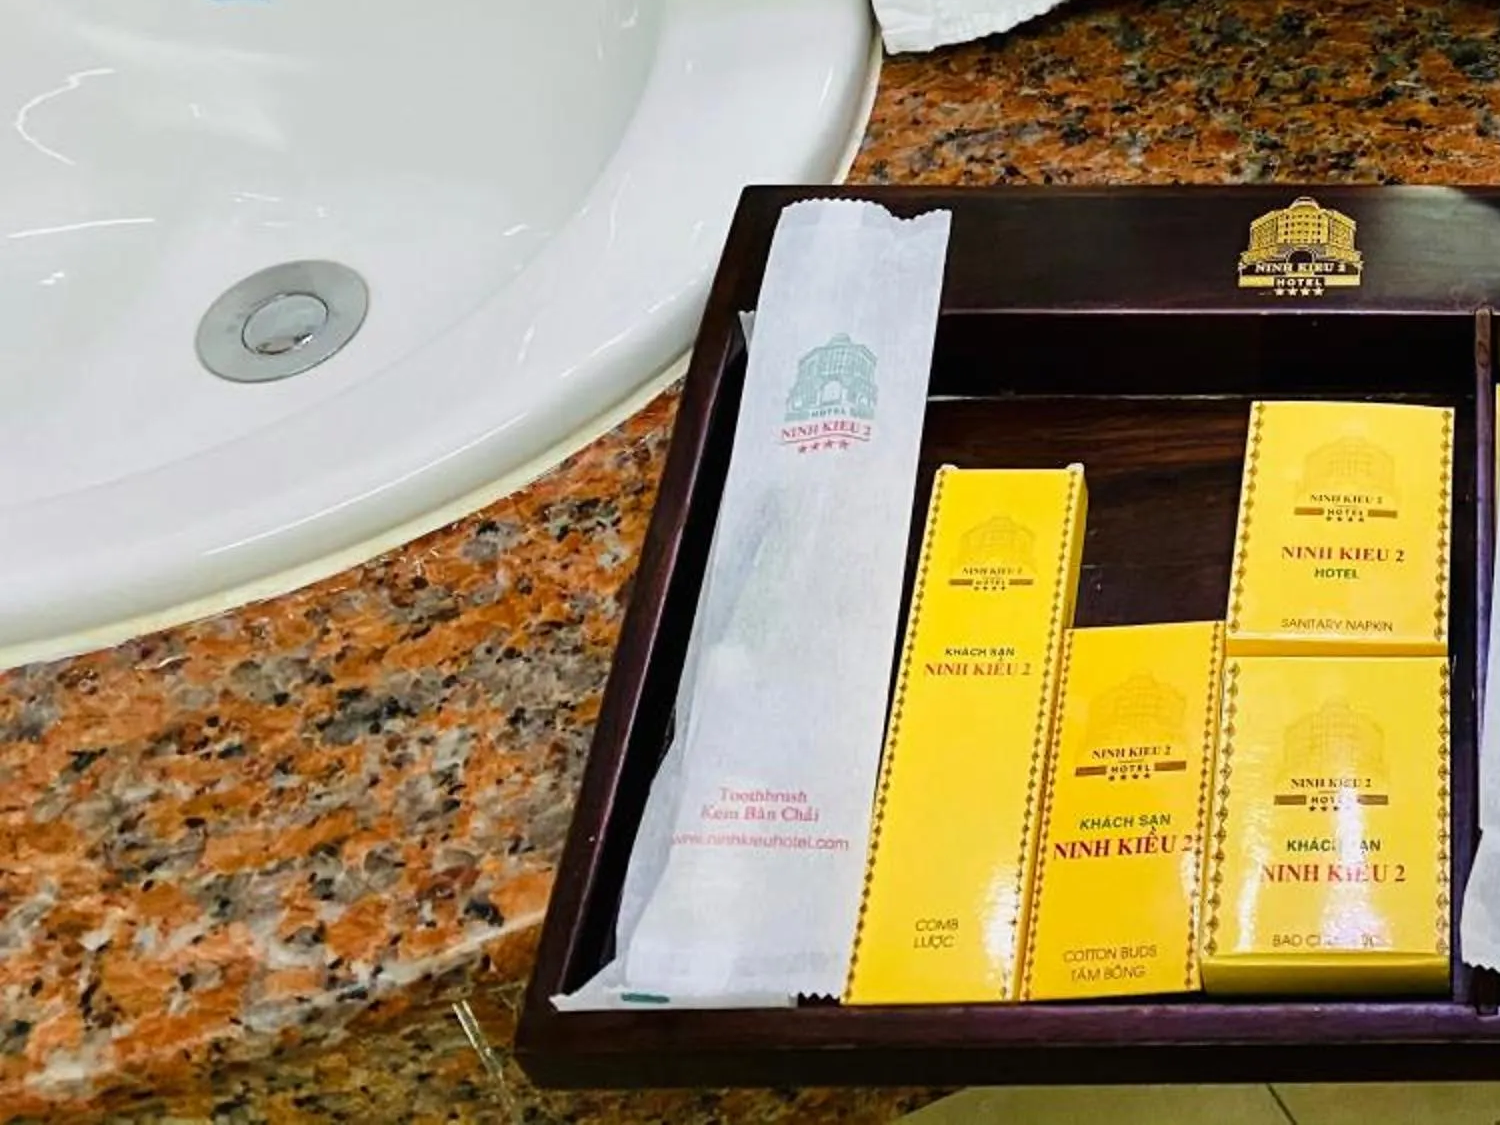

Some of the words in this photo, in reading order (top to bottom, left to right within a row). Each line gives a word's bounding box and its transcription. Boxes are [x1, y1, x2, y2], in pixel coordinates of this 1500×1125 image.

[1255, 263, 1293, 273] NINH
[1276, 277, 1322, 287] HOTEL
[781, 424, 819, 438] NINH
[1311, 493, 1341, 504] NINH
[1343, 494, 1372, 505] KIEU
[1327, 508, 1365, 517] HOTEL
[1281, 546, 1333, 560] NINH
[1339, 547, 1390, 562] KIEU
[1395, 549, 1406, 563] 2
[1313, 568, 1360, 580] HOTEL
[1280, 618, 1342, 630] SANITARY
[1345, 620, 1394, 633] NAPKIN
[925, 663, 969, 676] NINH
[1021, 662, 1032, 676] 2
[1092, 747, 1126, 759] NINH
[1128, 746, 1162, 758] KIEU
[1164, 745, 1172, 756] 2
[1110, 764, 1152, 774] HOTEL
[1291, 778, 1326, 789] NINH
[1364, 778, 1373, 788] 2
[719, 786, 808, 804] Toothbrush
[1079, 816, 1135, 831] KHÁCH
[1054, 838, 1111, 860] NINH
[1182, 834, 1193, 852] 2
[1286, 837, 1338, 852] KHÁC
[1261, 864, 1319, 882] NINH
[1394, 864, 1406, 883] 2
[915, 918, 959, 931] COMB
[1063, 947, 1118, 963] COTTON
[1121, 944, 1158, 960] BUDS
